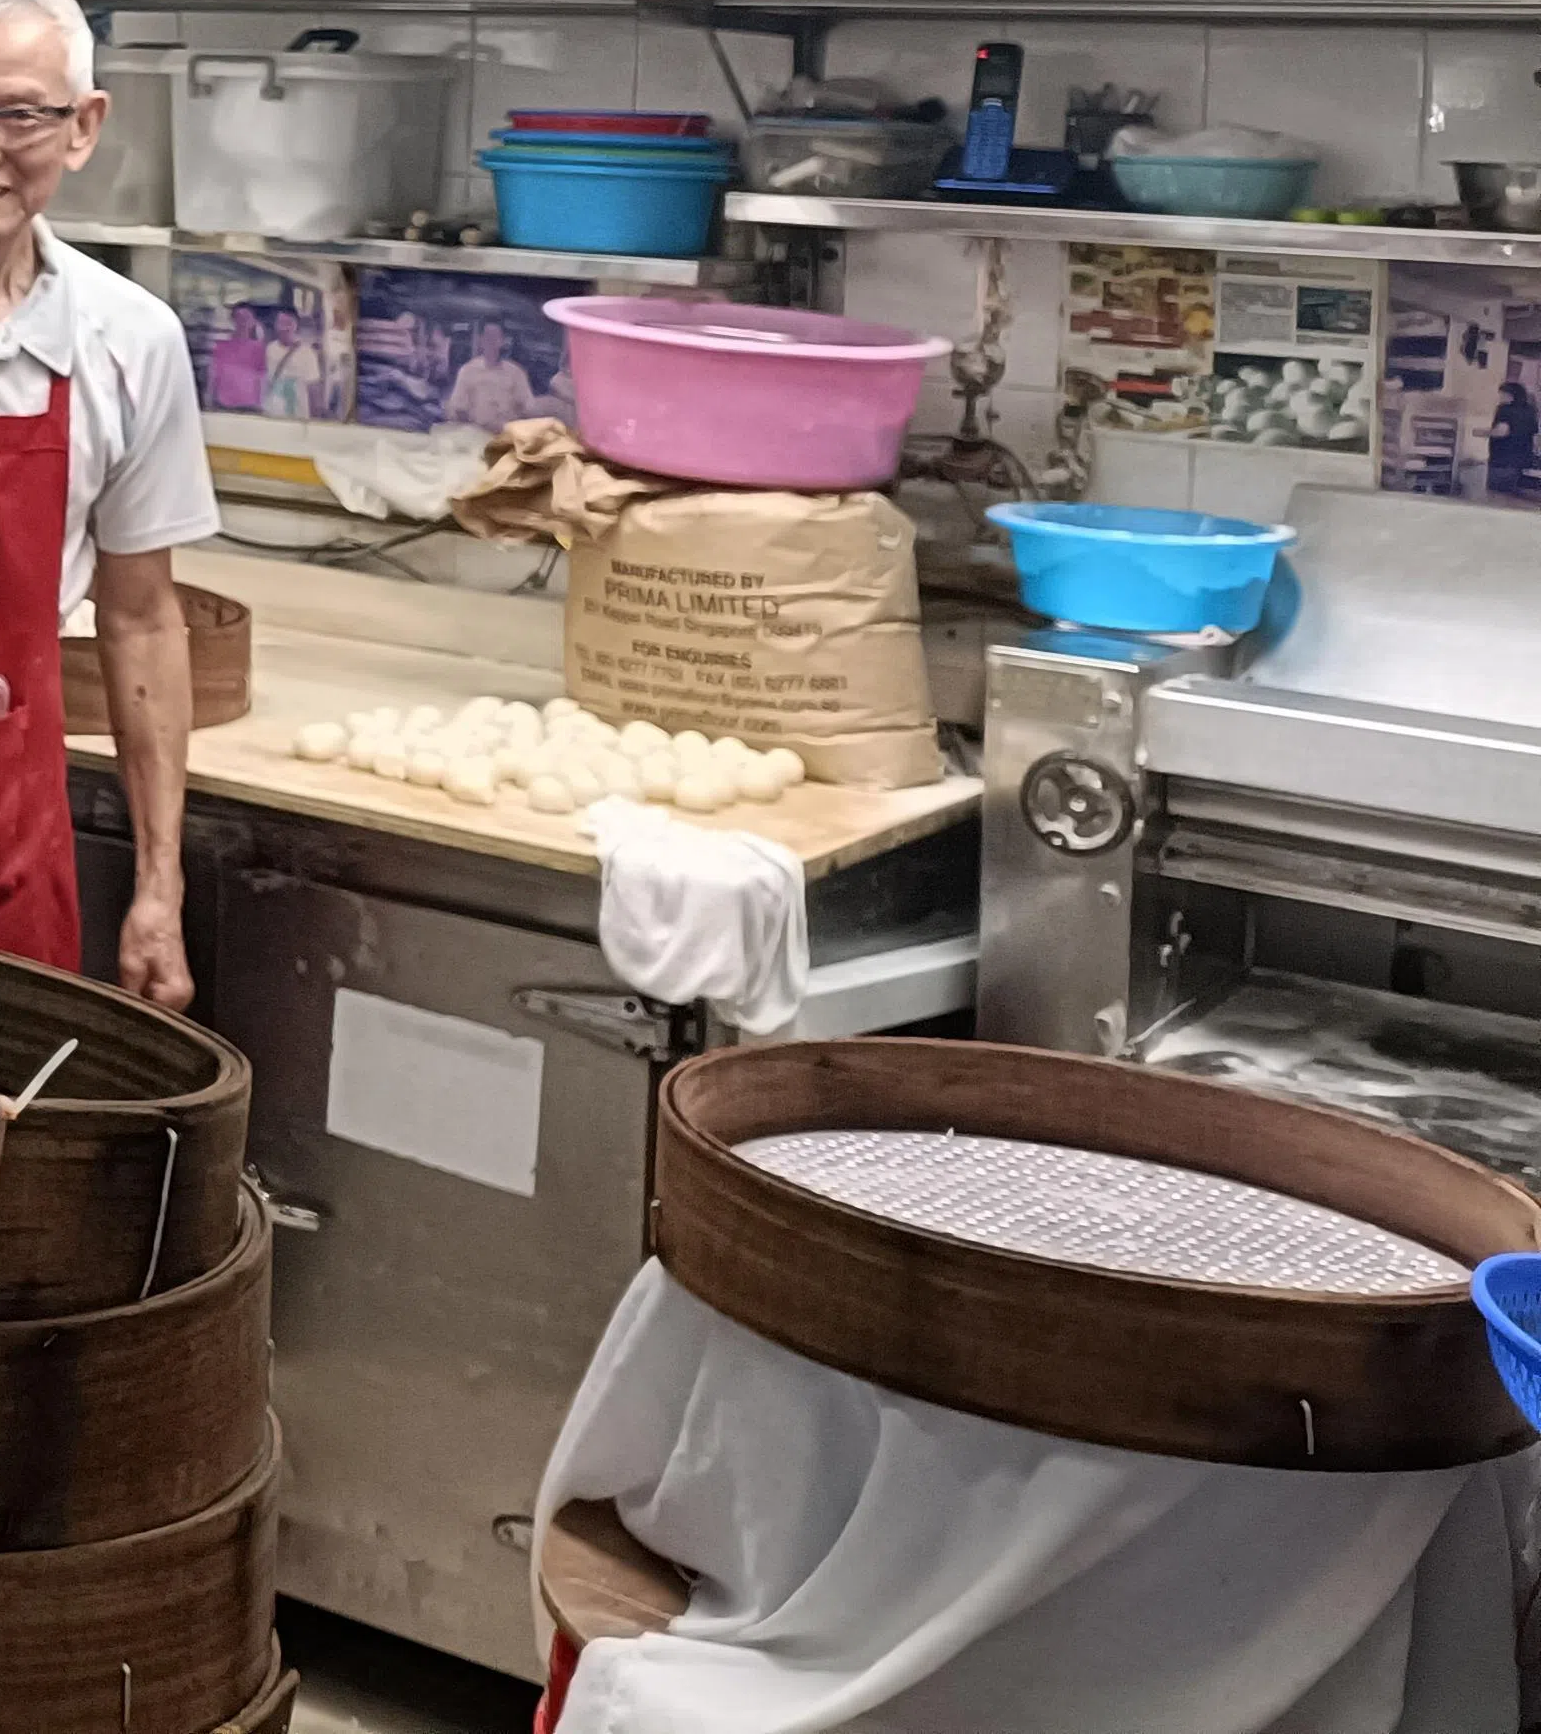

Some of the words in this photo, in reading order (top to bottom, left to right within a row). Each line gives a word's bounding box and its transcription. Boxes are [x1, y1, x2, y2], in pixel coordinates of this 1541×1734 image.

[611, 558, 736, 589] MANUFACTURED
[740, 572, 765, 589] BY
[604, 577, 669, 612] PRIMA
[674, 592, 779, 619] LIMITED
